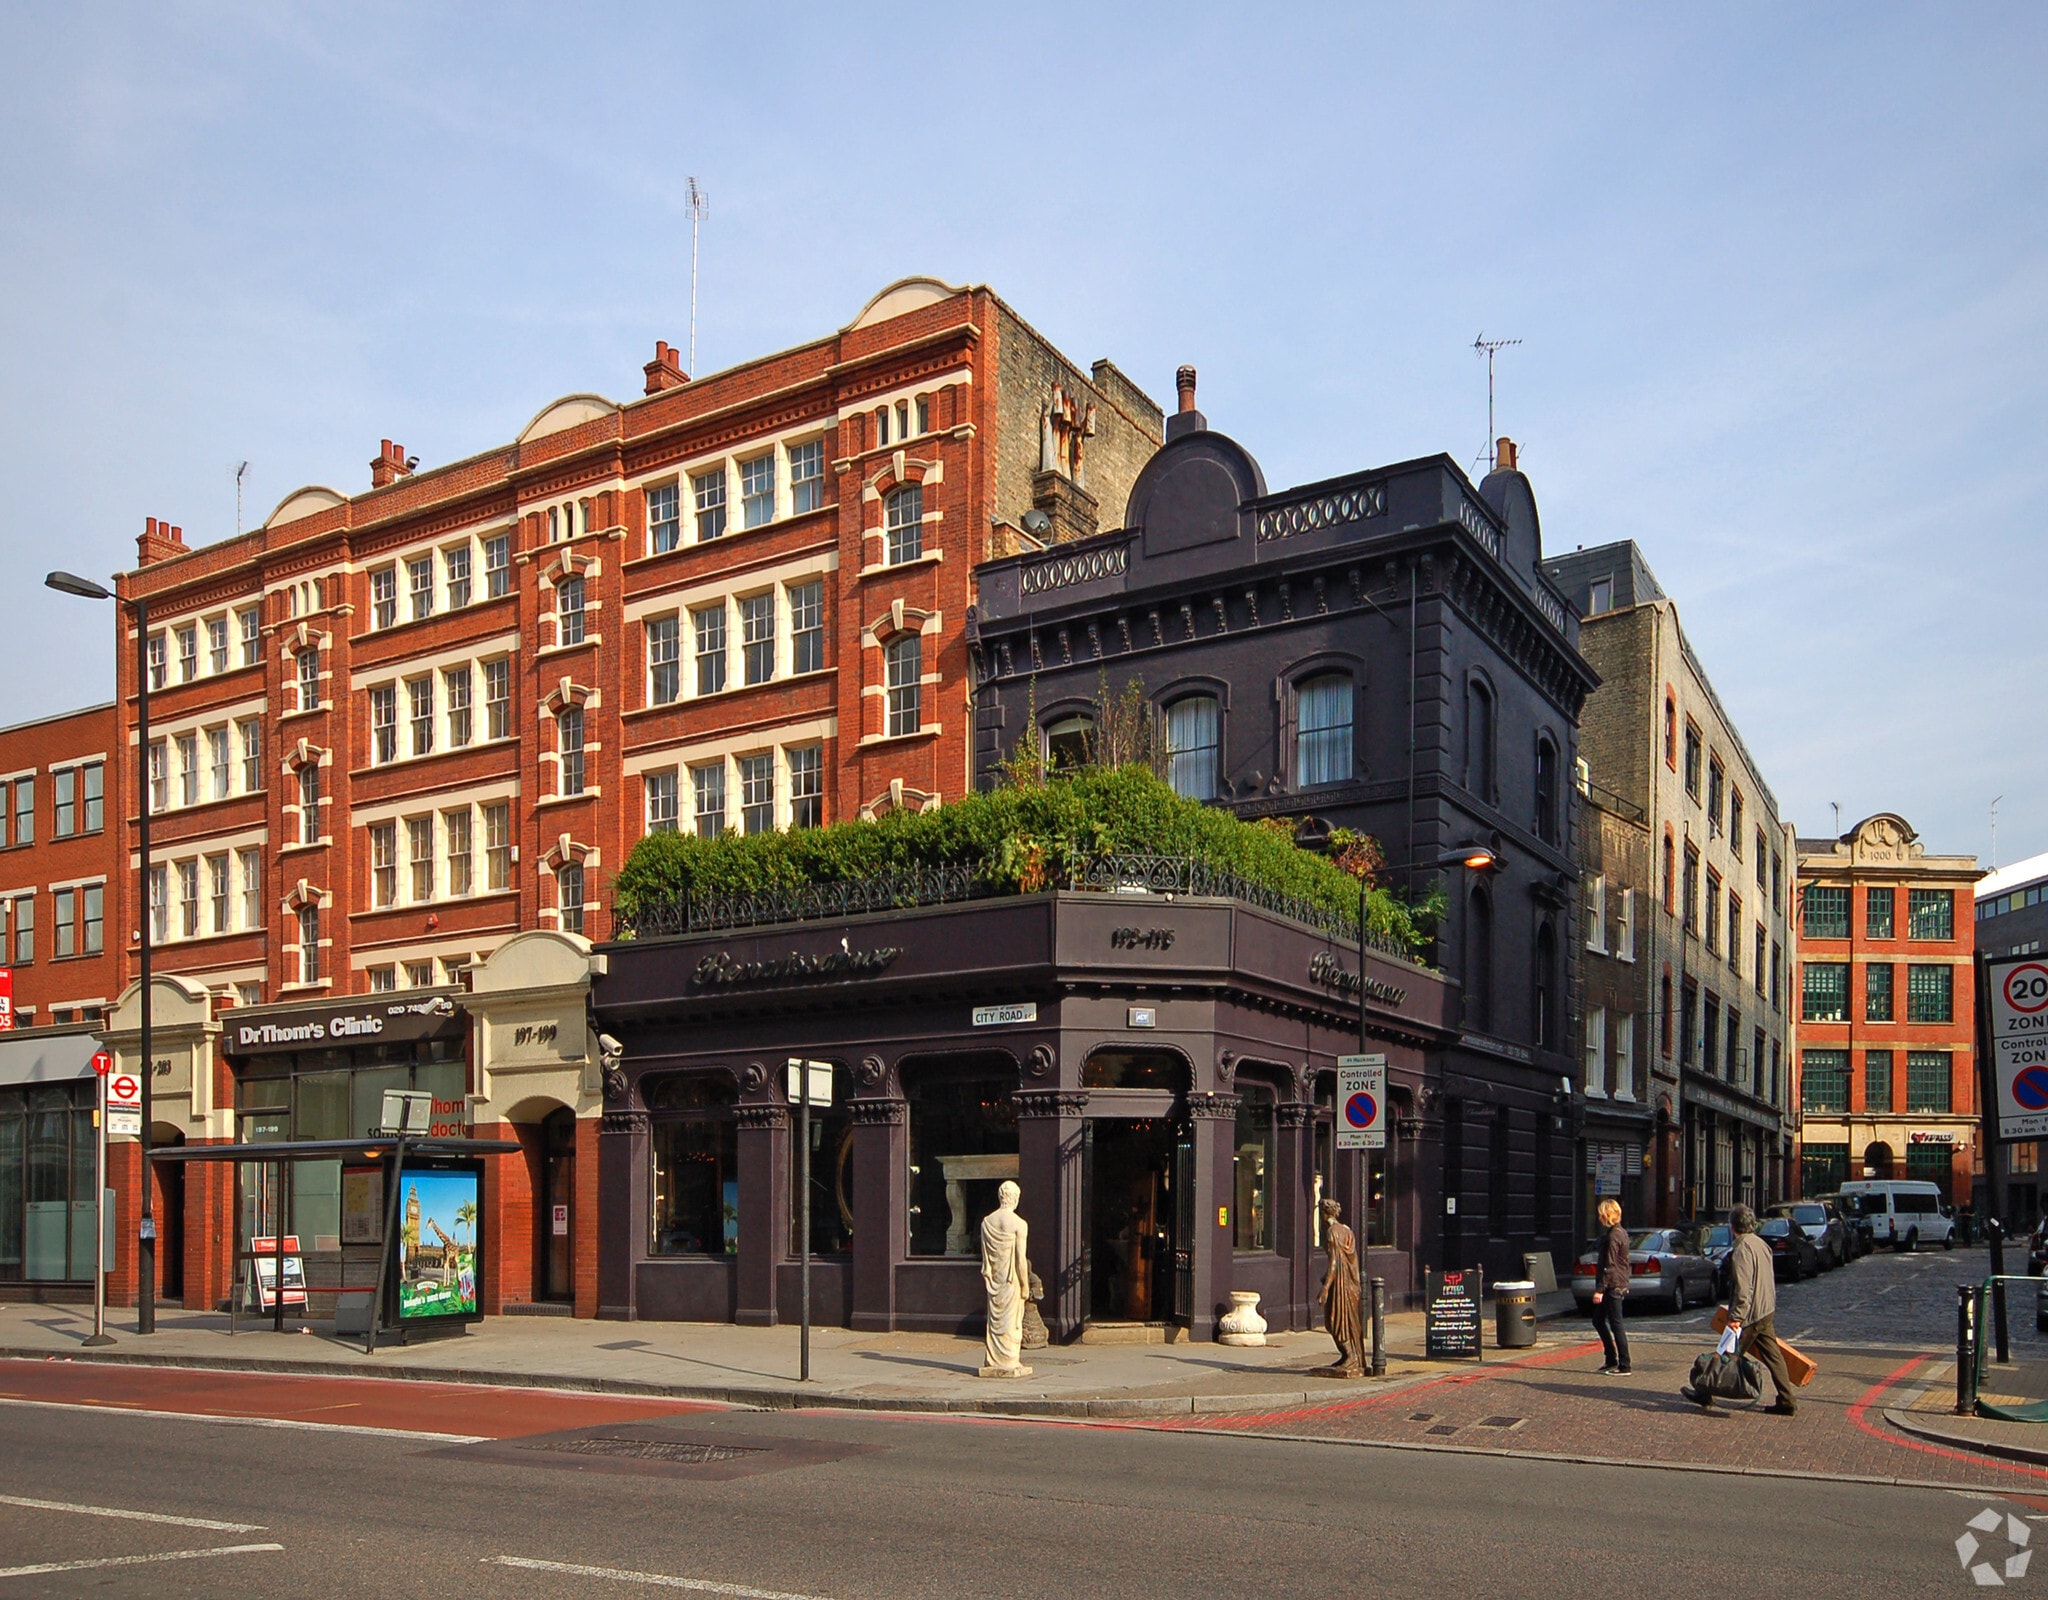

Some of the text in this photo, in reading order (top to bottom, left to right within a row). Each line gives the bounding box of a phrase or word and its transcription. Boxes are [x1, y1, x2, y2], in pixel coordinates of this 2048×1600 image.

[1870, 851, 1891, 862] 1900
[1307, 951, 1408, 1003] Renassance
[2012, 977, 2048, 999] 20
[975, 1013, 995, 1024] CITY
[1000, 1010, 1023, 1022] ROAD
[2008, 1016, 2048, 1030] ZON
[329, 1014, 383, 1038] Clinic
[1340, 1069, 1382, 1079] Controlled
[1346, 1081, 1377, 1091] ZONE
